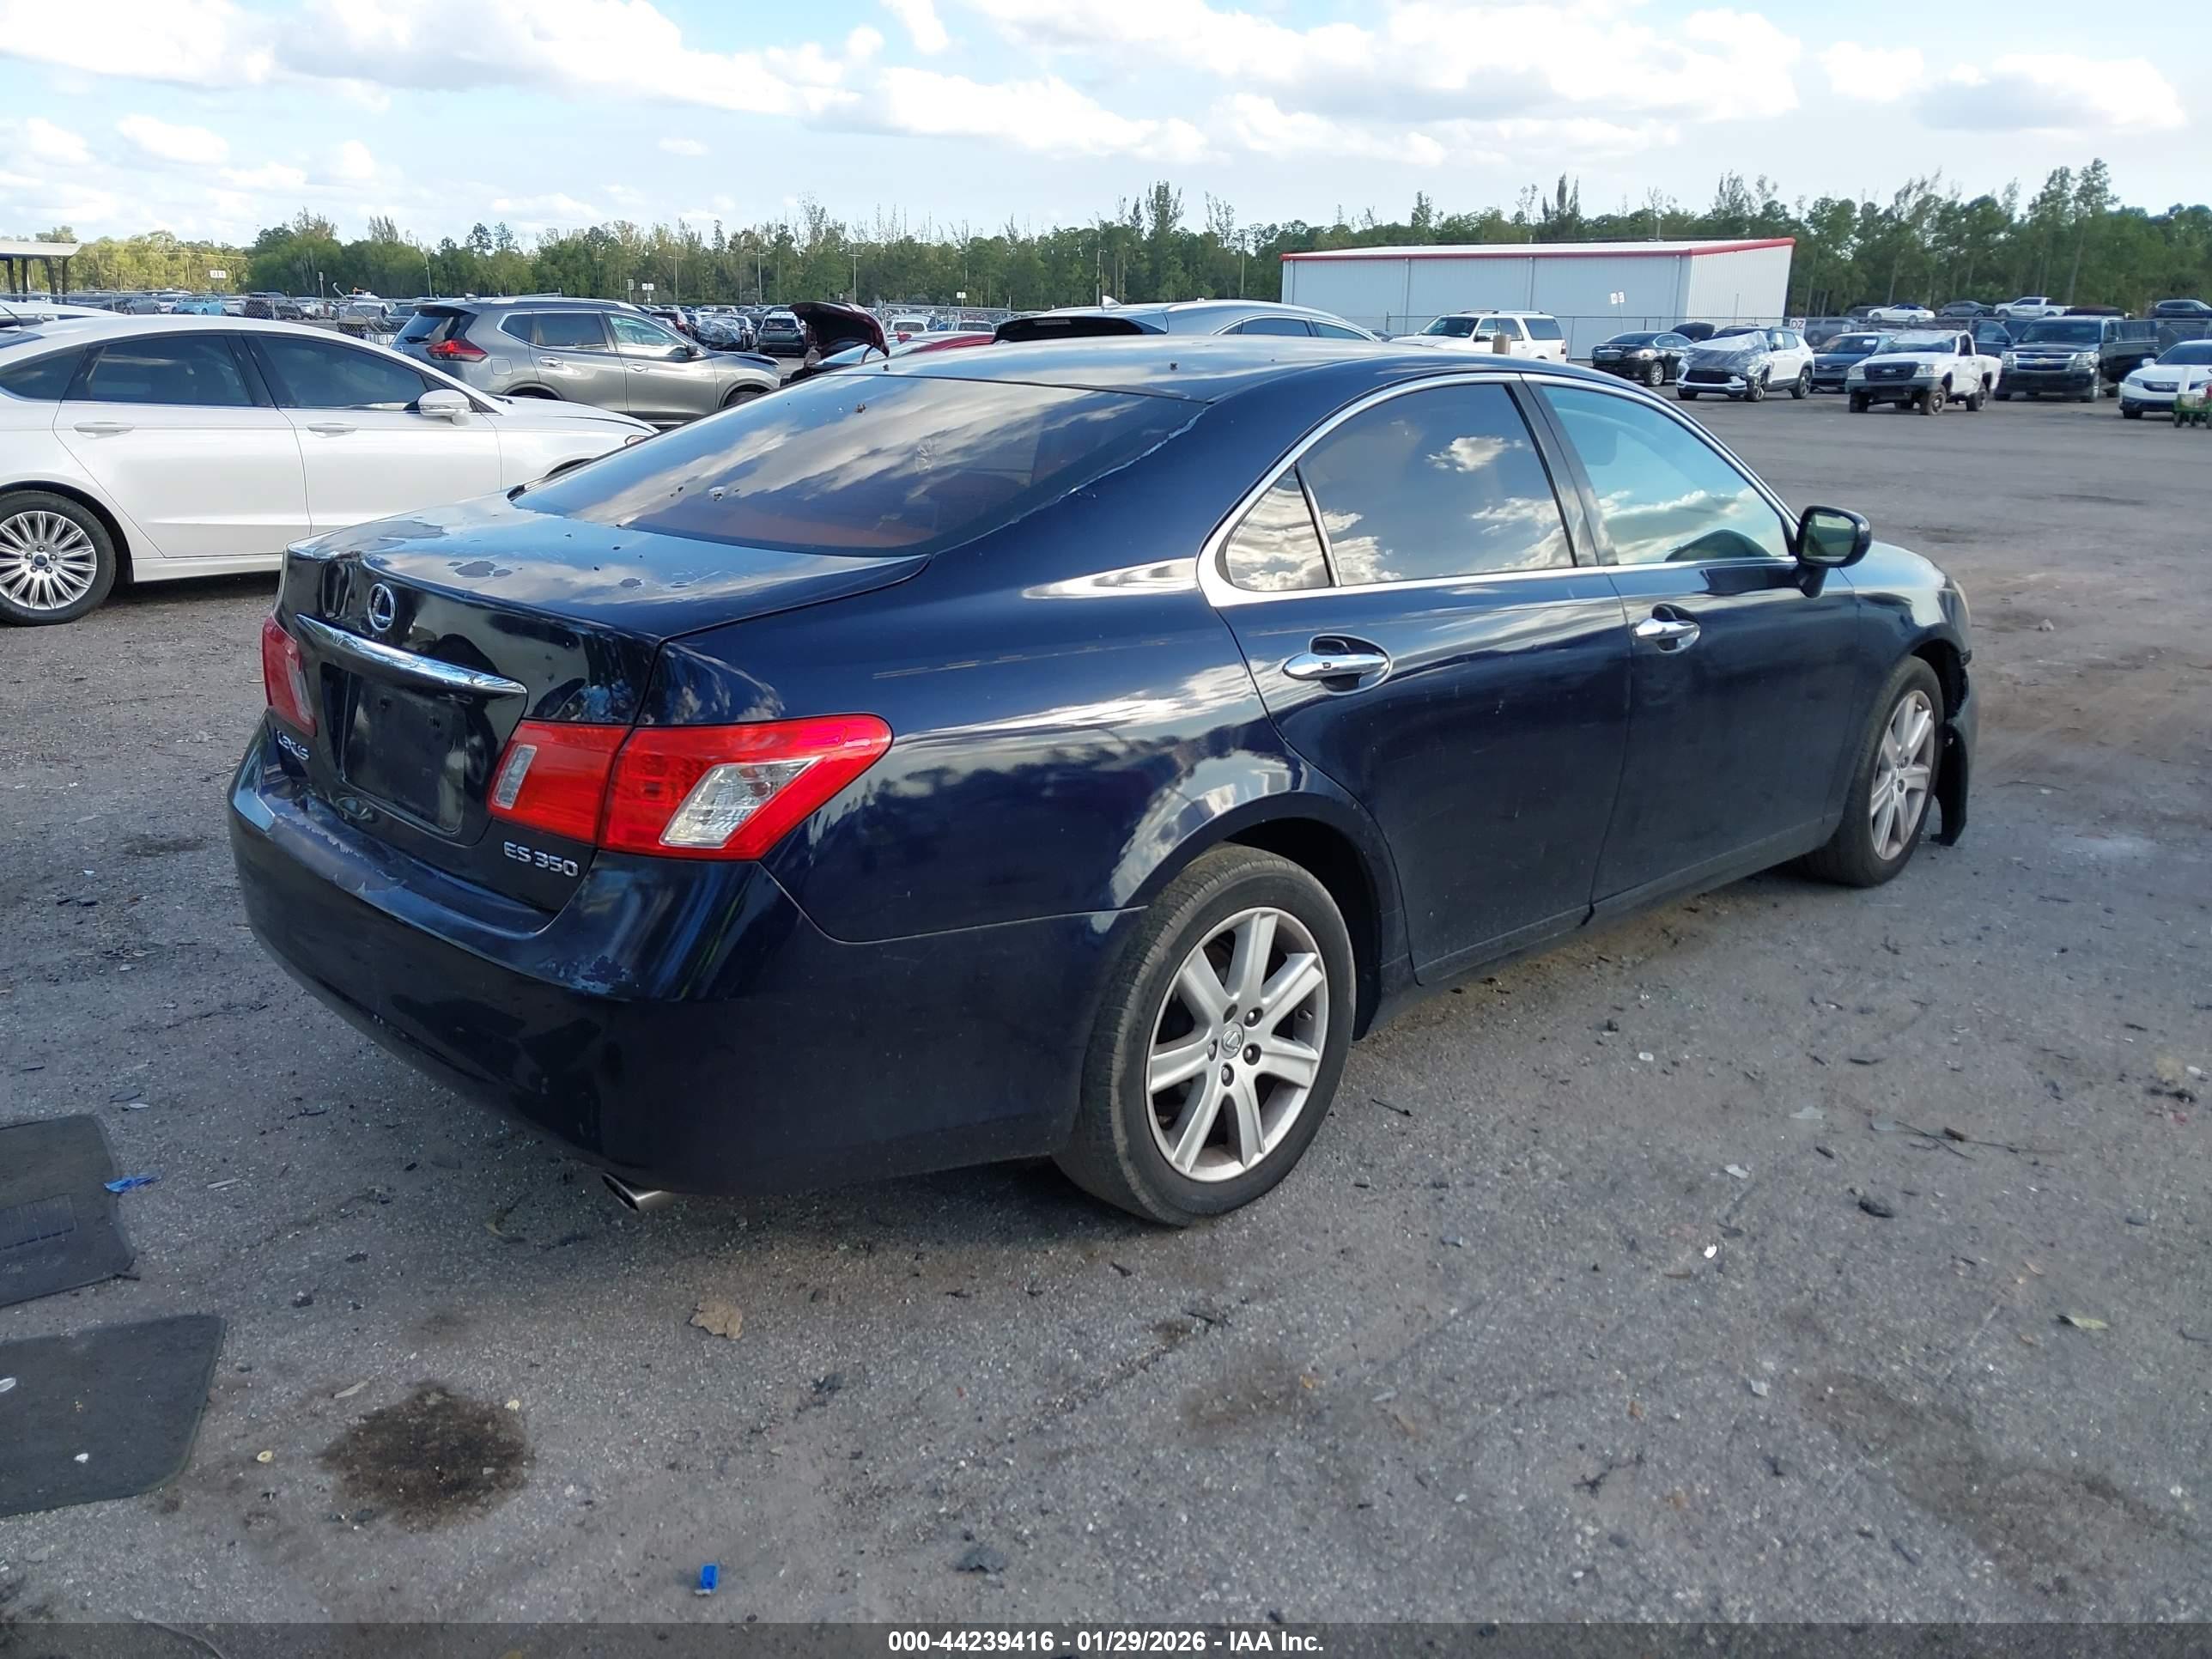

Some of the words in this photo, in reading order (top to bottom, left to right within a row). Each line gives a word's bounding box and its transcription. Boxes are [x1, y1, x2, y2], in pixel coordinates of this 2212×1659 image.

[1791, 319, 1804, 330] DZ
[503, 841, 532, 863] ES
[533, 850, 579, 877] 350
